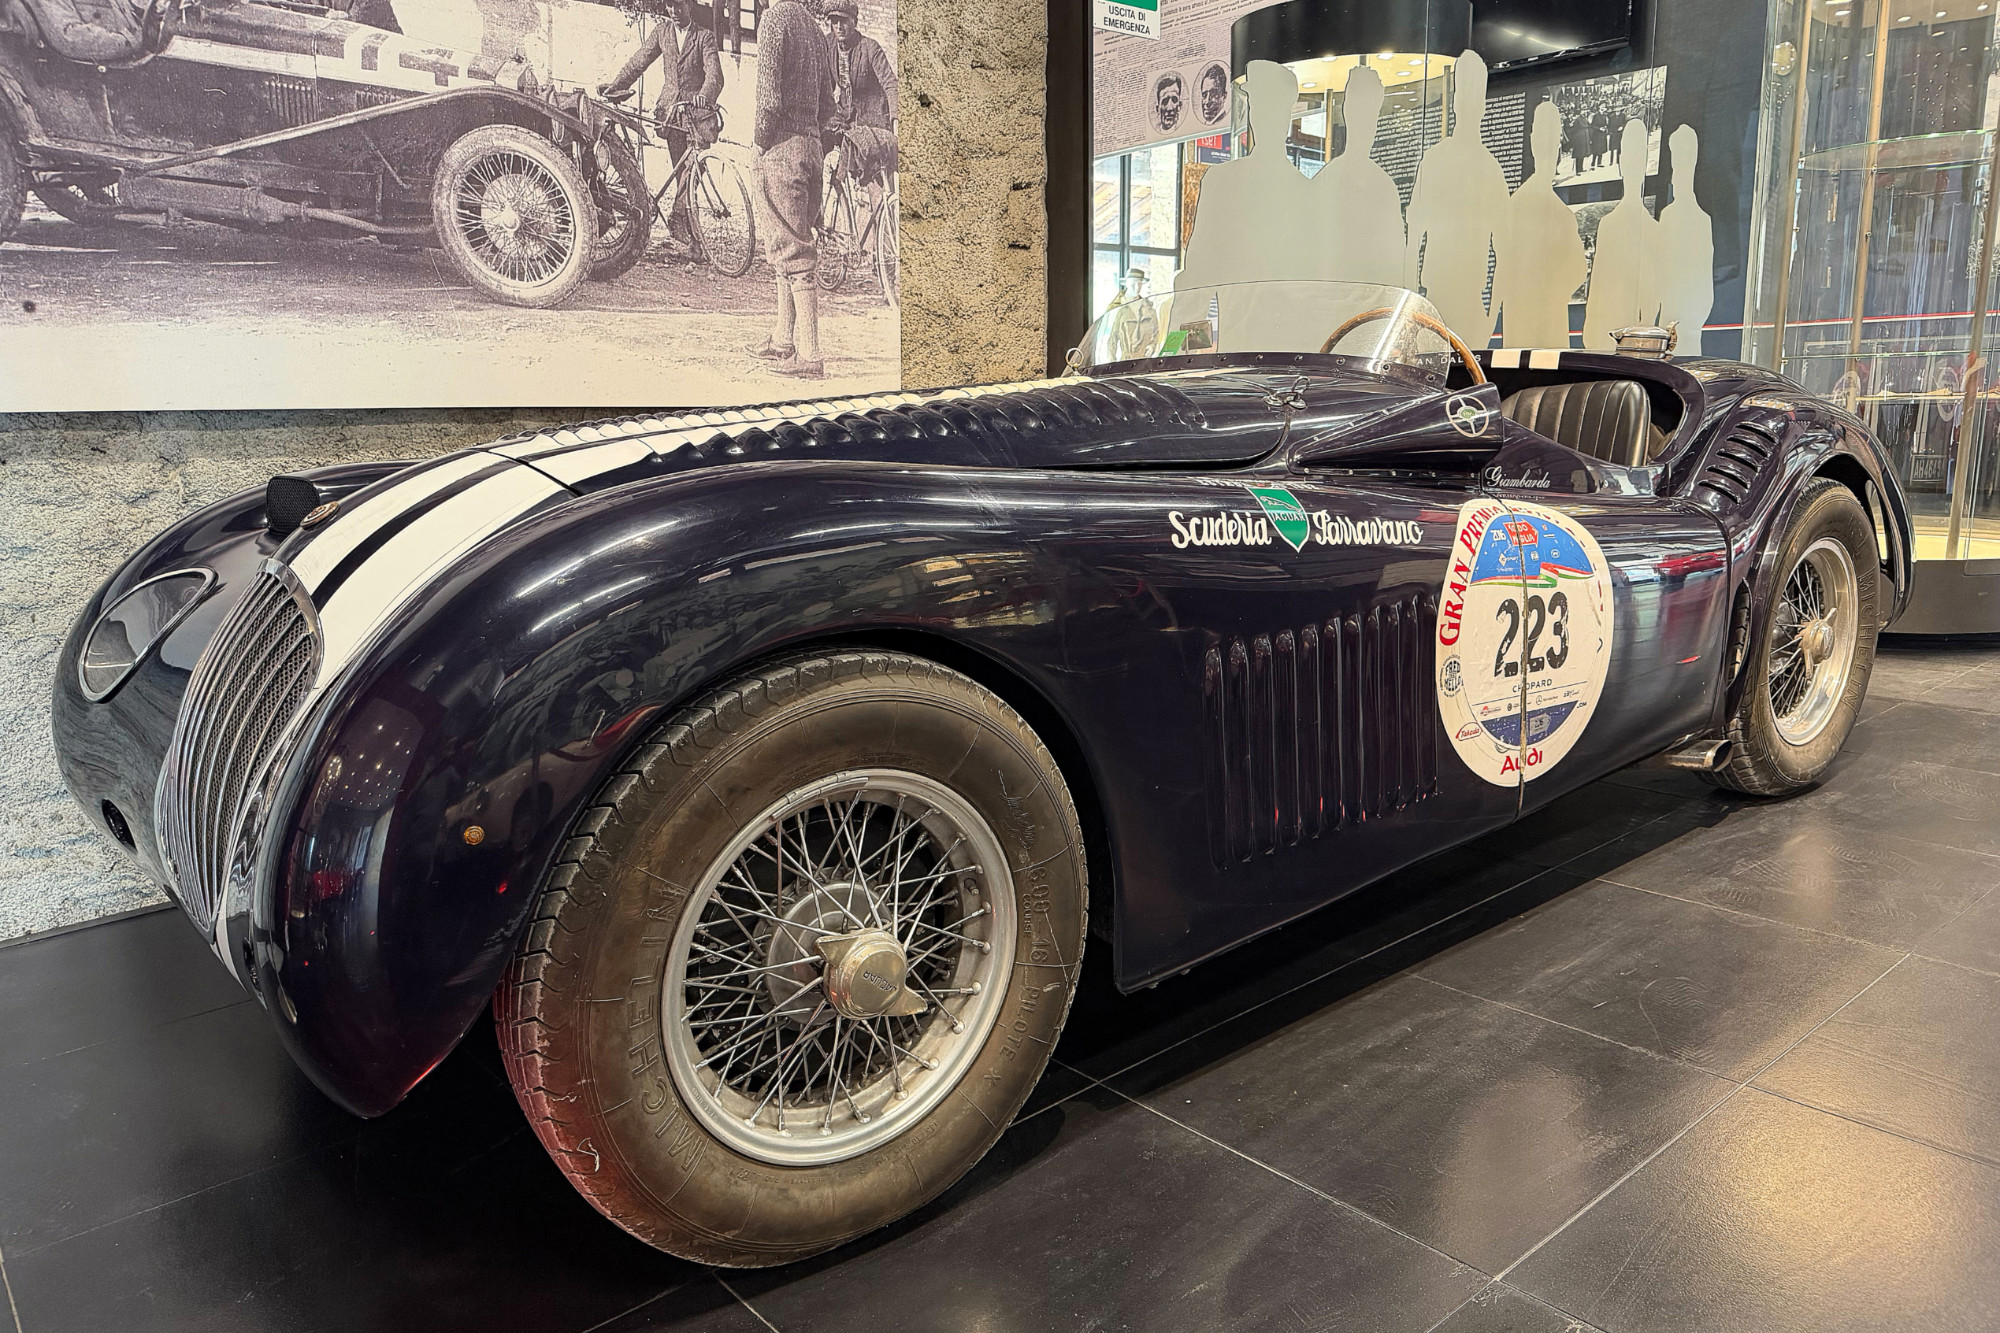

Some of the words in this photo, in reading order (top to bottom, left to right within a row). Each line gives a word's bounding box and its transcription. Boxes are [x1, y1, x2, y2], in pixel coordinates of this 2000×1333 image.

[1103, 16, 1151, 36] EMERGENZA
[1108, 5, 1136, 20] USCITA
[1138, 11, 1146, 22] DI
[1485, 466, 1551, 488] Giambarda
[1168, 511, 1272, 549] Scuderia
[1270, 511, 1307, 523] JAGUAR
[1439, 557, 1472, 646] GRAN
[1494, 591, 1570, 678] 223
[1844, 572, 1874, 709] MICHELIN
[1500, 748, 1543, 775] Audi
[863, 971, 897, 992] JAGUAR
[627, 900, 703, 1172] MICHELIN
[1000, 984, 1041, 1062] PILOTE
